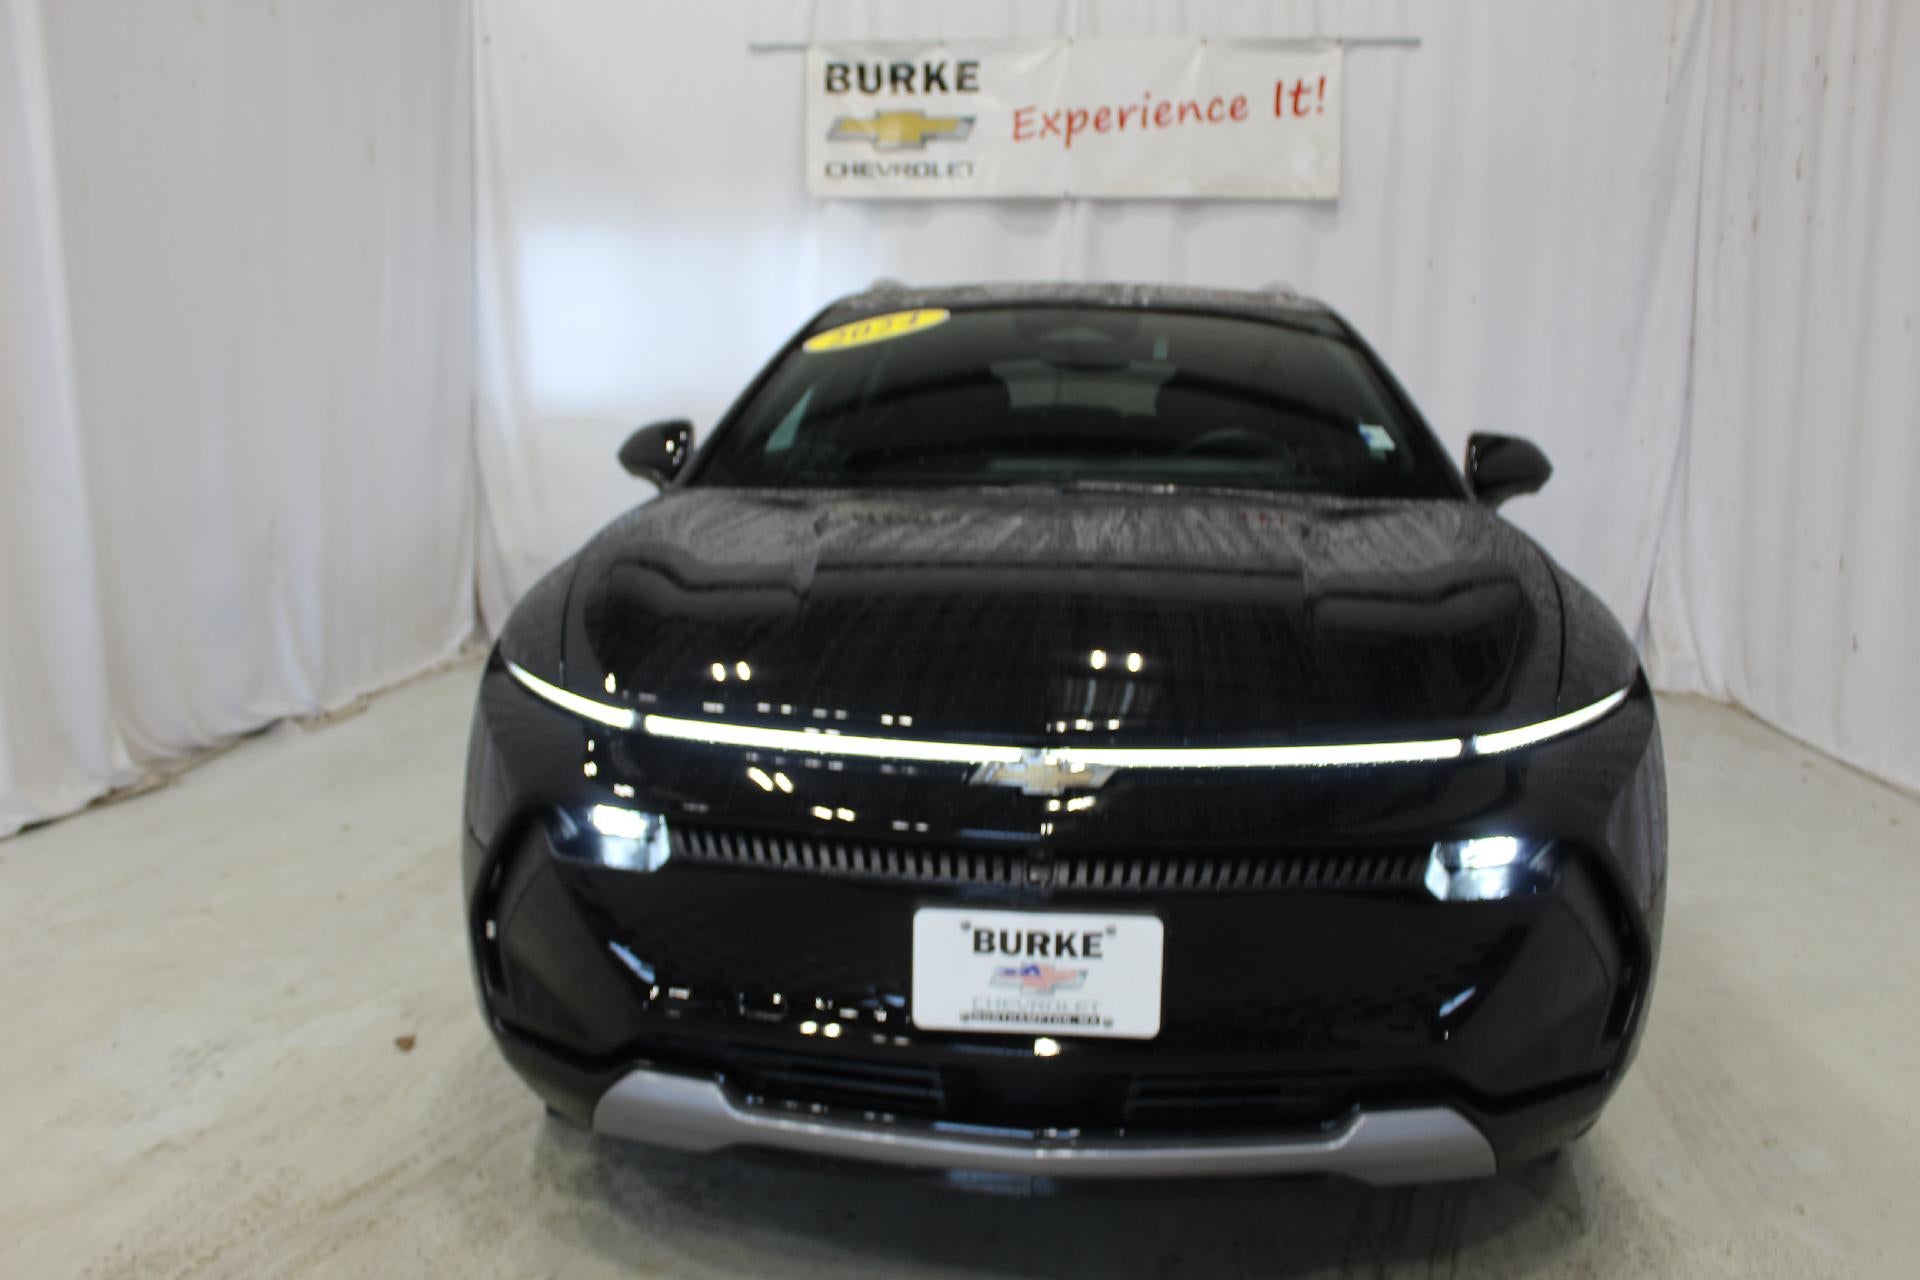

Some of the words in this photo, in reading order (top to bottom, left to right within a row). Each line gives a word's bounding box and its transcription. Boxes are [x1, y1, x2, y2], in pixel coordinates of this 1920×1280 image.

[825, 61, 981, 94] BURKE
[1012, 92, 1248, 148] Experience
[1273, 76, 1328, 118] It!
[825, 160, 975, 179] CHEVROLET
[973, 929, 1104, 958] BURKE
[972, 997, 1099, 1013] CHEVROLET
